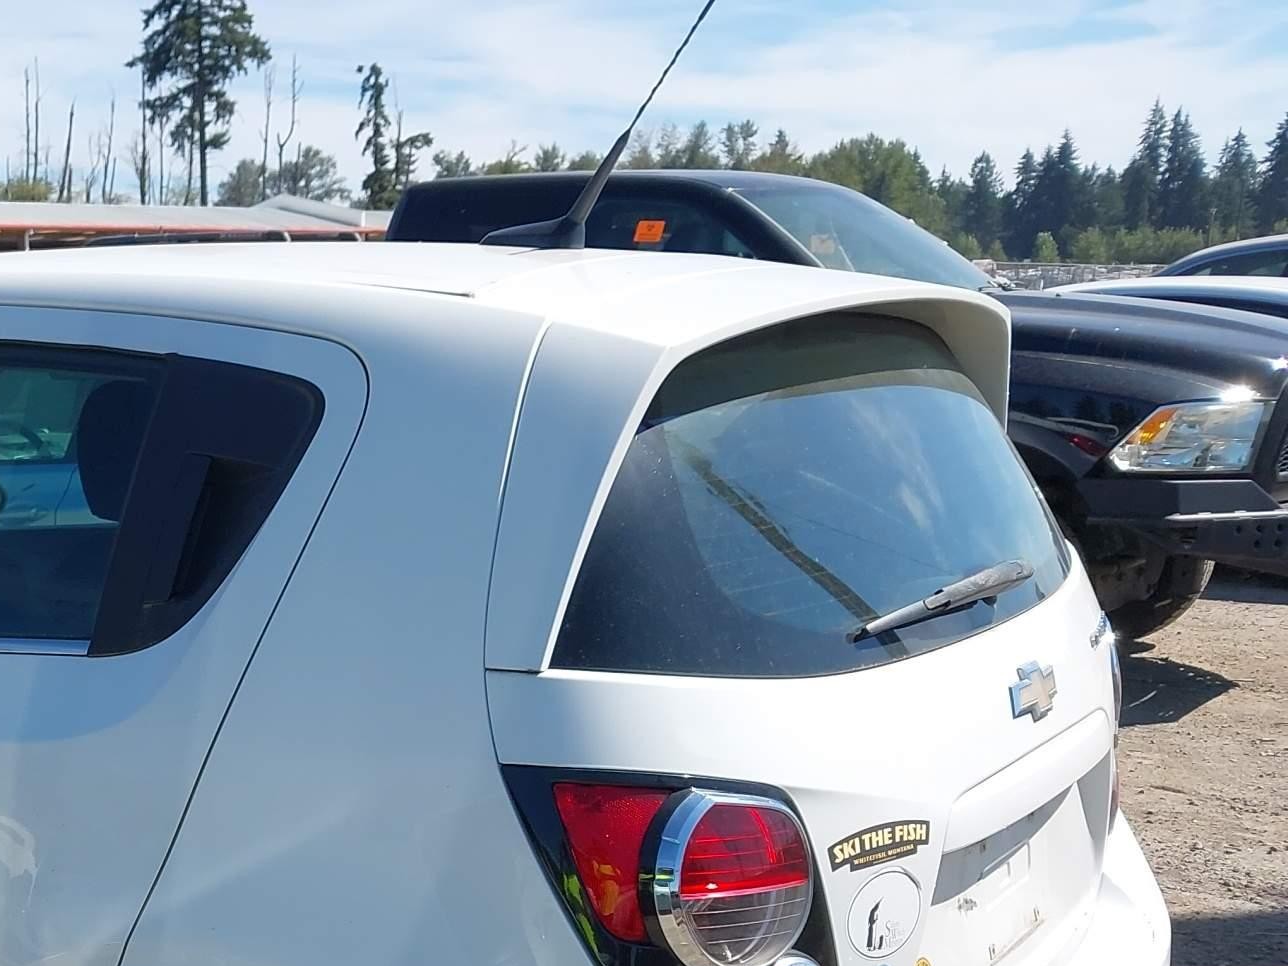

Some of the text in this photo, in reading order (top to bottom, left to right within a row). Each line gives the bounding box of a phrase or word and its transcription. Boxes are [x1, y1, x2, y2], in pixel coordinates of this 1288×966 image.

[833, 824, 927, 863] SKI THE FISH
